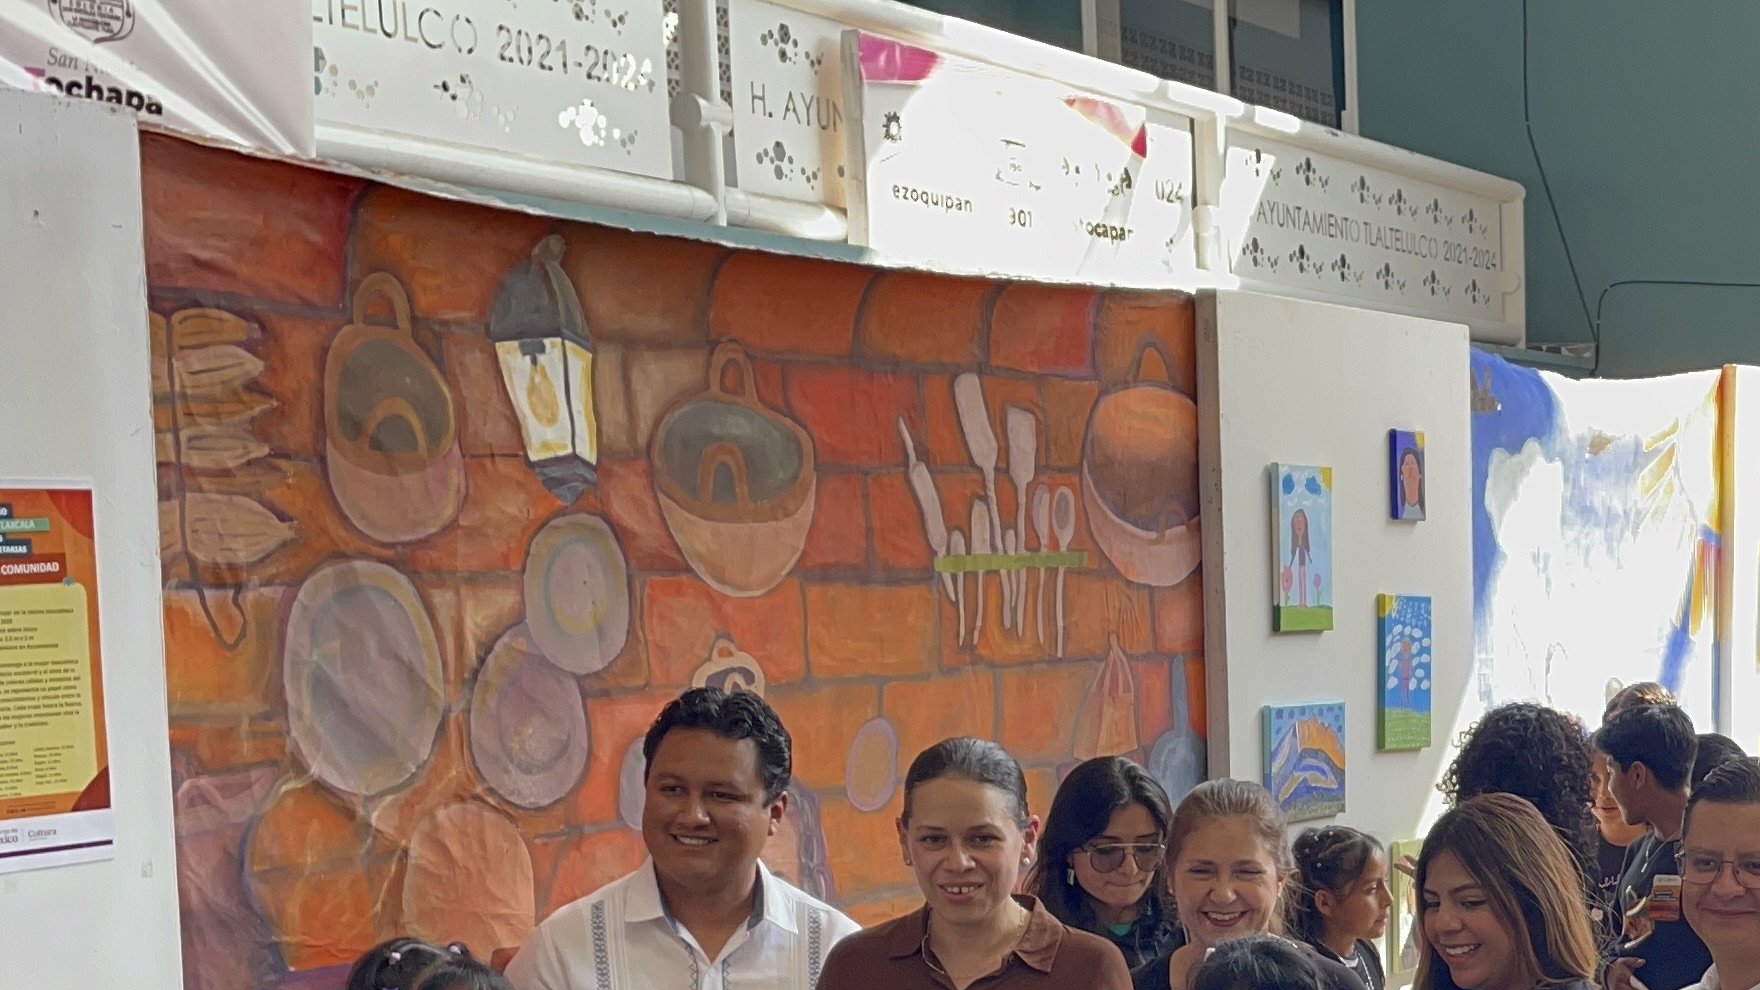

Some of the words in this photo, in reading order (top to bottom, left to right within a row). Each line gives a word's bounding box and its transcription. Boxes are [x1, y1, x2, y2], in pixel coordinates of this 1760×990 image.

[47, 47, 79, 71] San
[496, 23, 656, 93] 2021-2024
[750, 80, 774, 118] H.
[1256, 200, 1360, 243] AYUNTAMIENTO
[1363, 221, 1438, 259] TLALTELULCO
[1443, 240, 1497, 271] 2021-2024
[0, 561, 60, 575] COMUNIDAD
